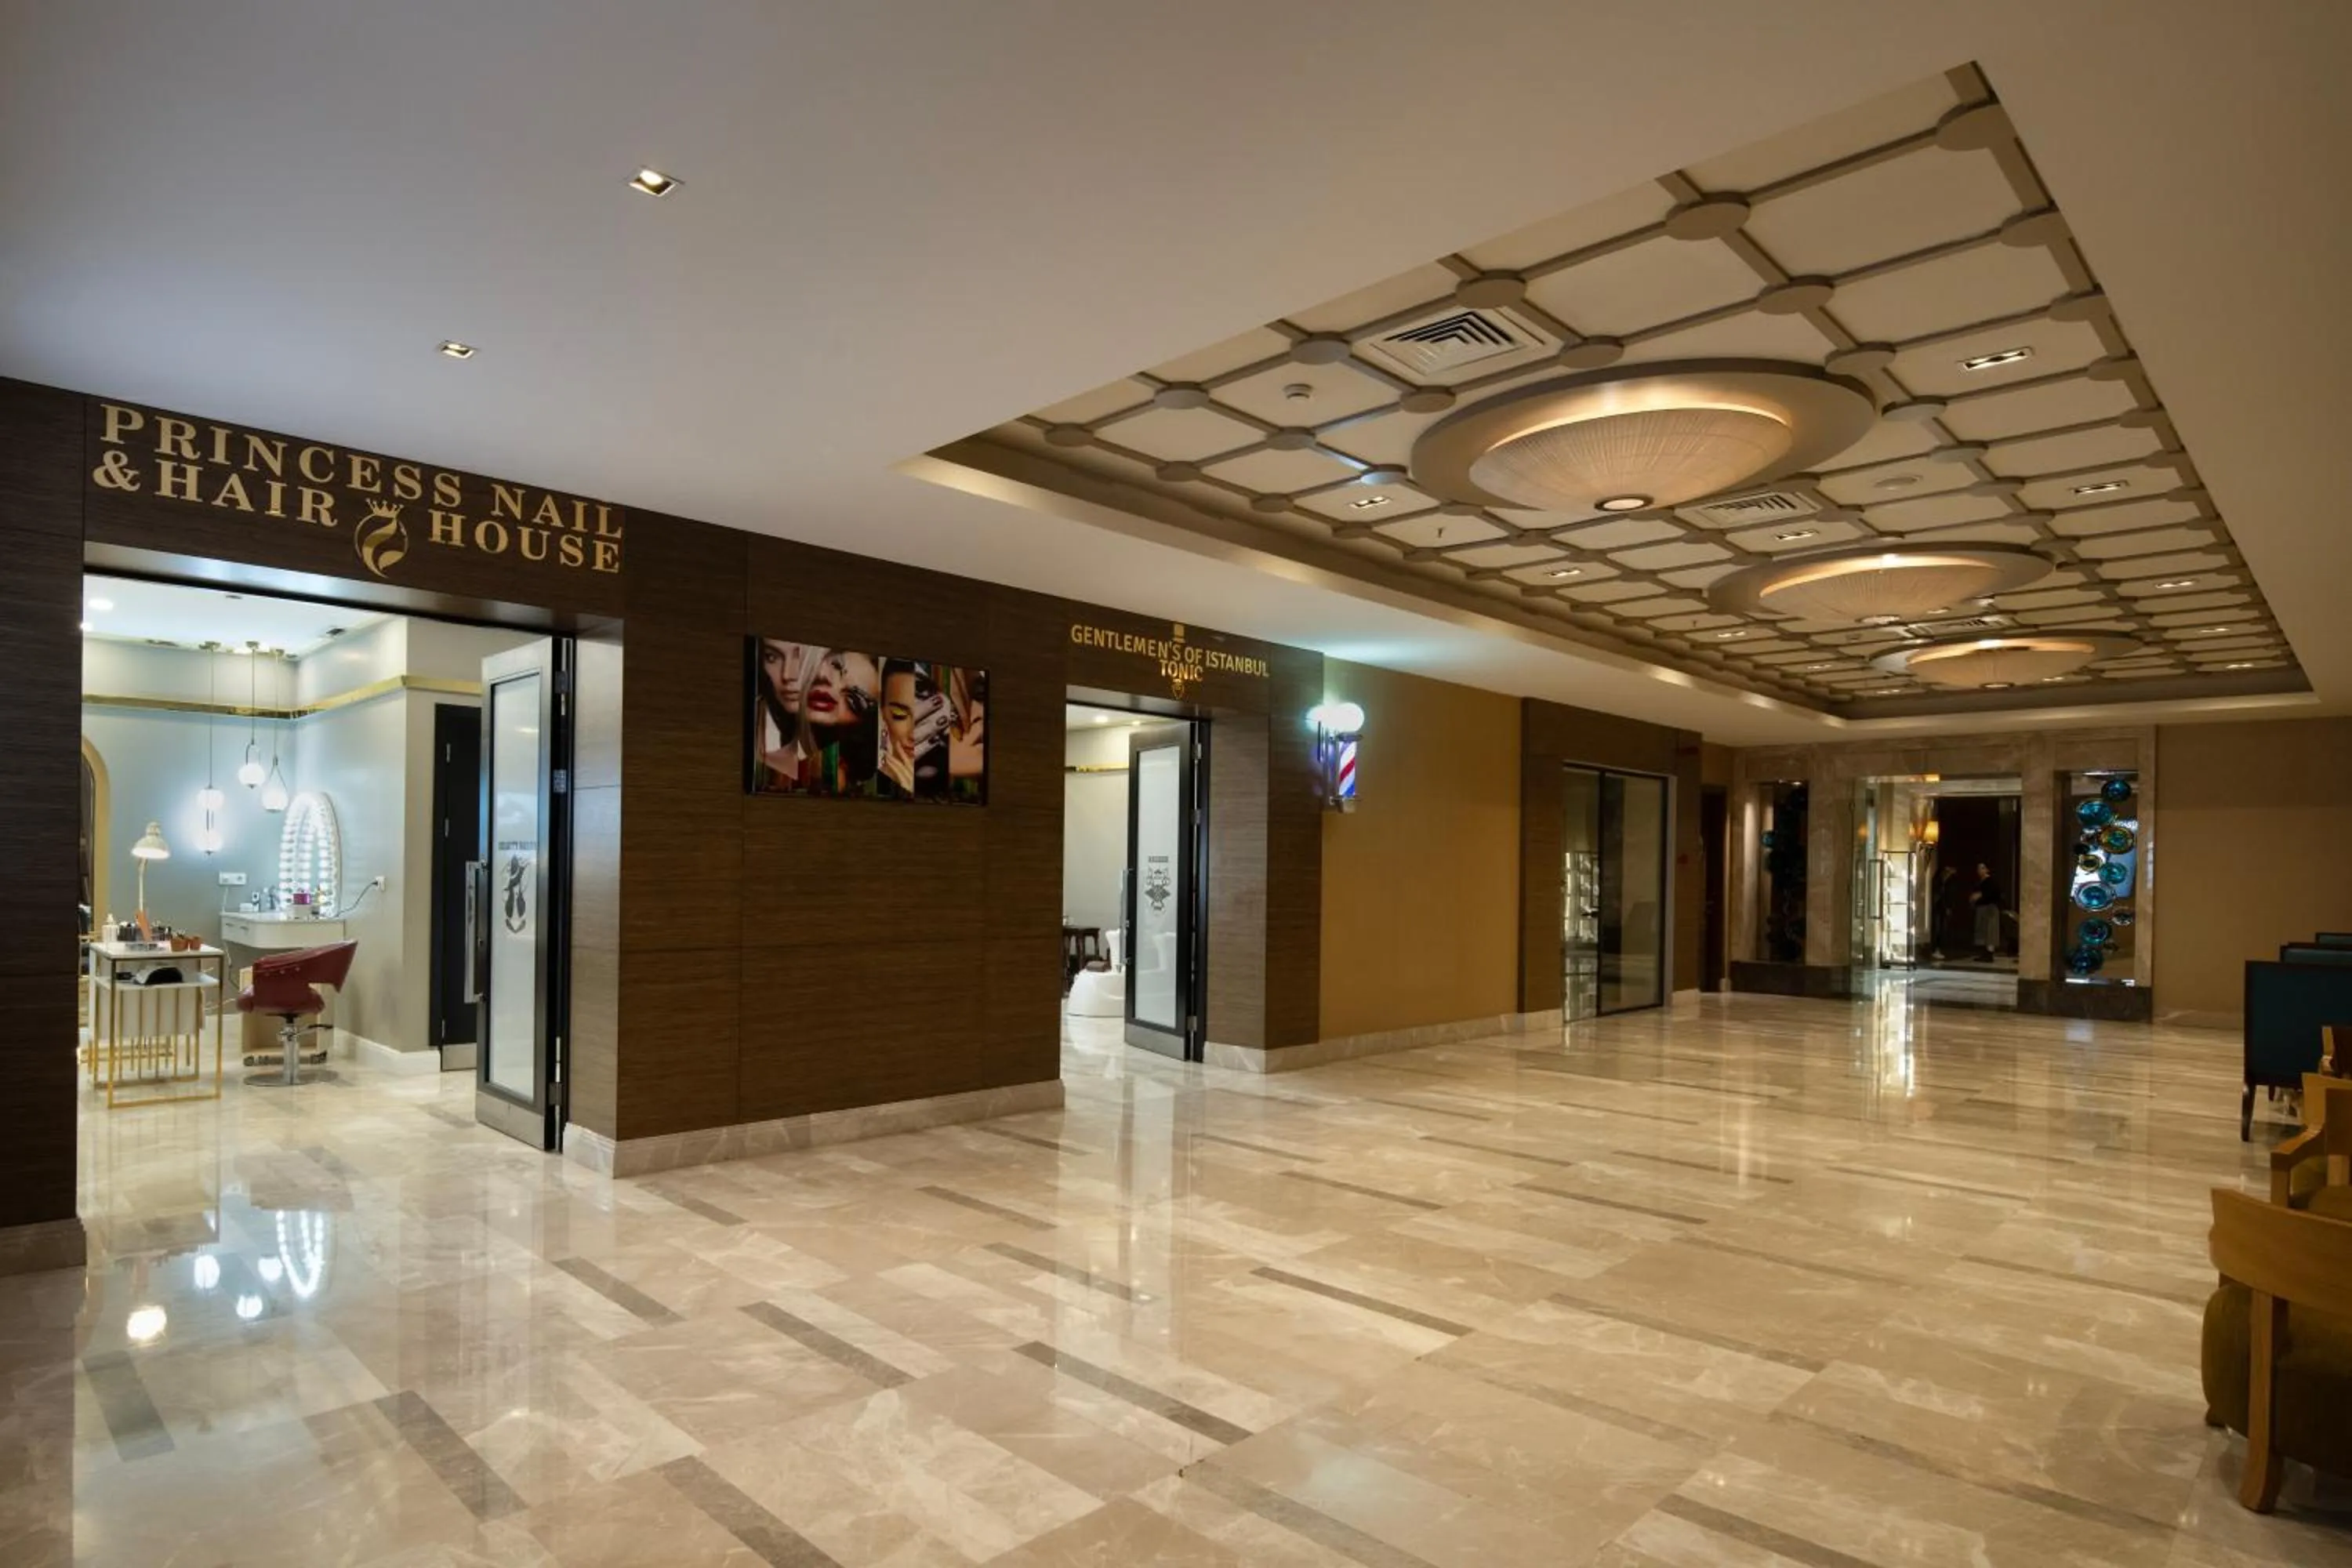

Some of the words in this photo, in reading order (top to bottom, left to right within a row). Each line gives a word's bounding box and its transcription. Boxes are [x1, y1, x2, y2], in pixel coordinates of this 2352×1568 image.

[92, 450, 141, 492] &
[154, 459, 339, 528] HAIR
[427, 508, 621, 574] HOUSE
[100, 403, 463, 508] PRINCESS
[489, 484, 622, 539] NAIL
[1071, 625, 1181, 661] GENTLEMEN'S
[1185, 646, 1203, 665] OF
[1205, 650, 1270, 677] ISTANBUL
[1160, 659, 1204, 681] TONIC
